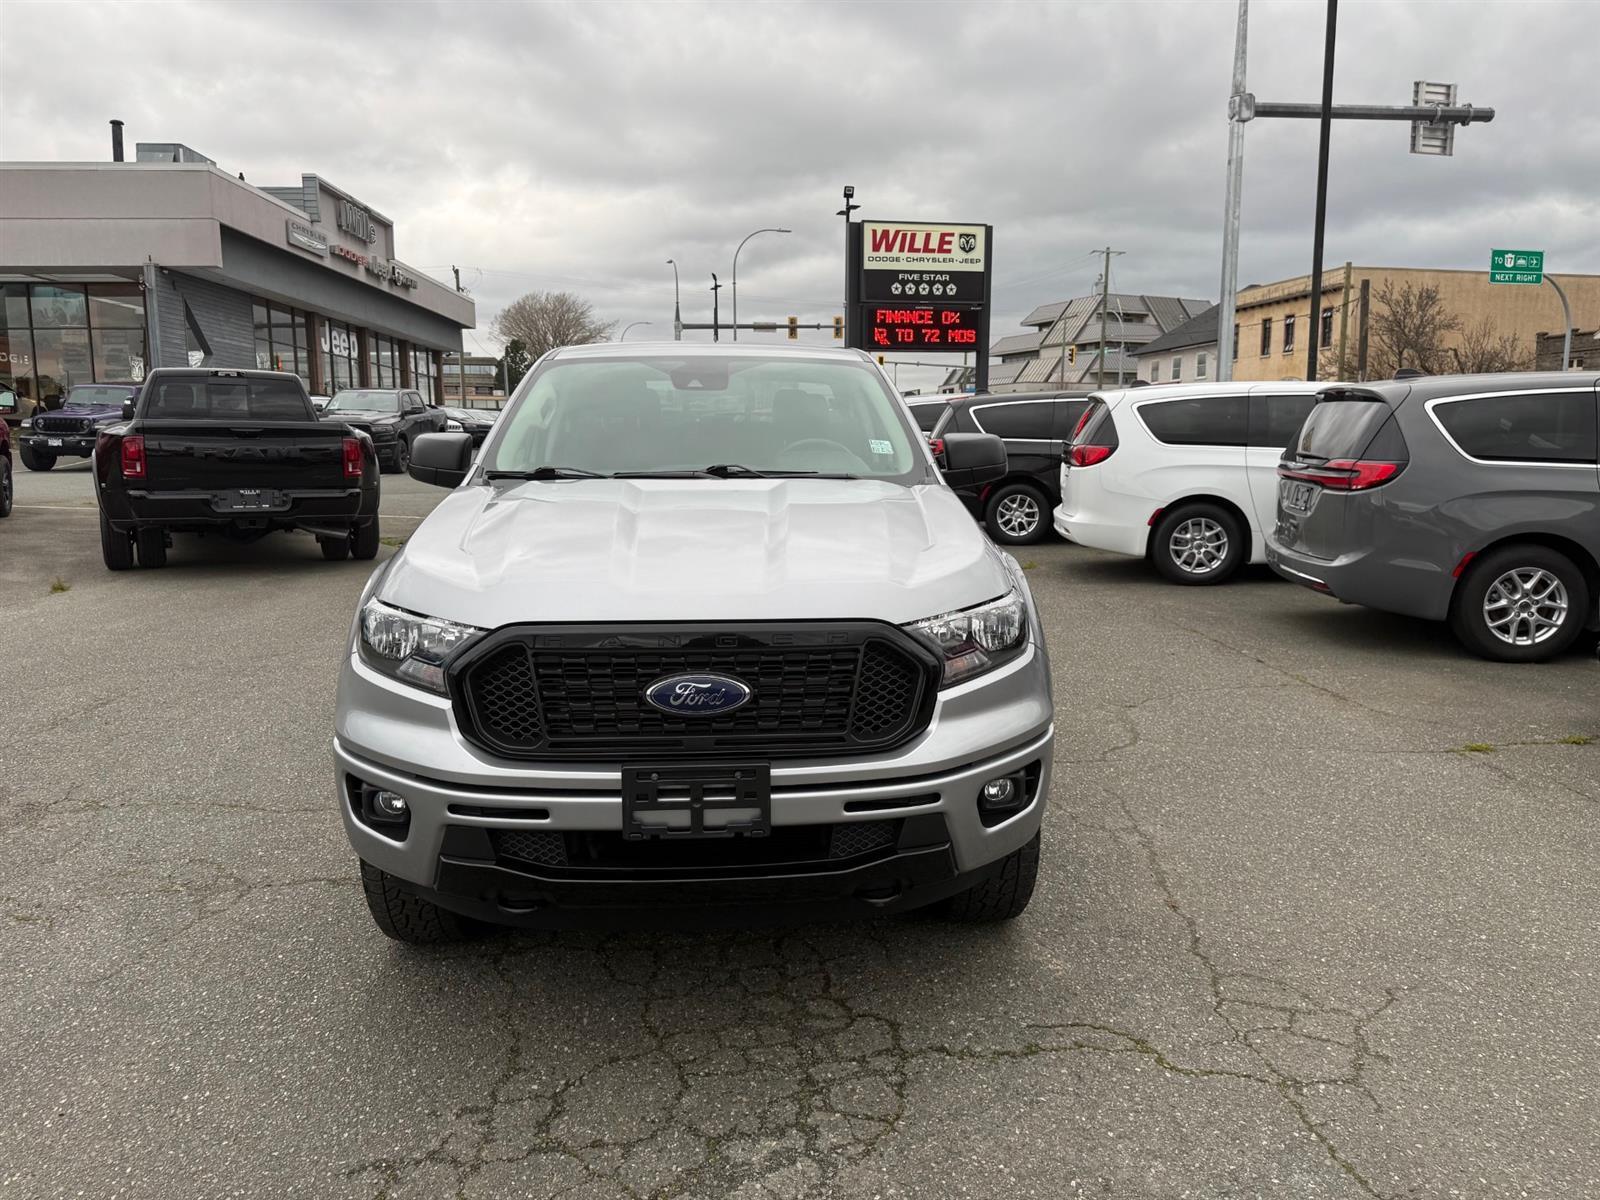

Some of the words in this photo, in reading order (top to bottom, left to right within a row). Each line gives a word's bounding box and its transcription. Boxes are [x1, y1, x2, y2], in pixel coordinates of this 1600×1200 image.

[871, 228, 955, 254] WILLE
[1494, 256, 1504, 264] TO
[898, 273, 920, 281] FIVE
[1495, 273, 1514, 281] NEXT
[1516, 273, 1537, 282] RIGHT
[876, 309, 934, 324] FINANCE
[941, 311, 961, 324] 0%
[320, 320, 359, 359] Jeep
[895, 328, 914, 341] TO
[921, 328, 940, 343] 72
[947, 329, 976, 343] MOS
[543, 632, 849, 648] RANGER
[669, 682, 727, 706] Ford
